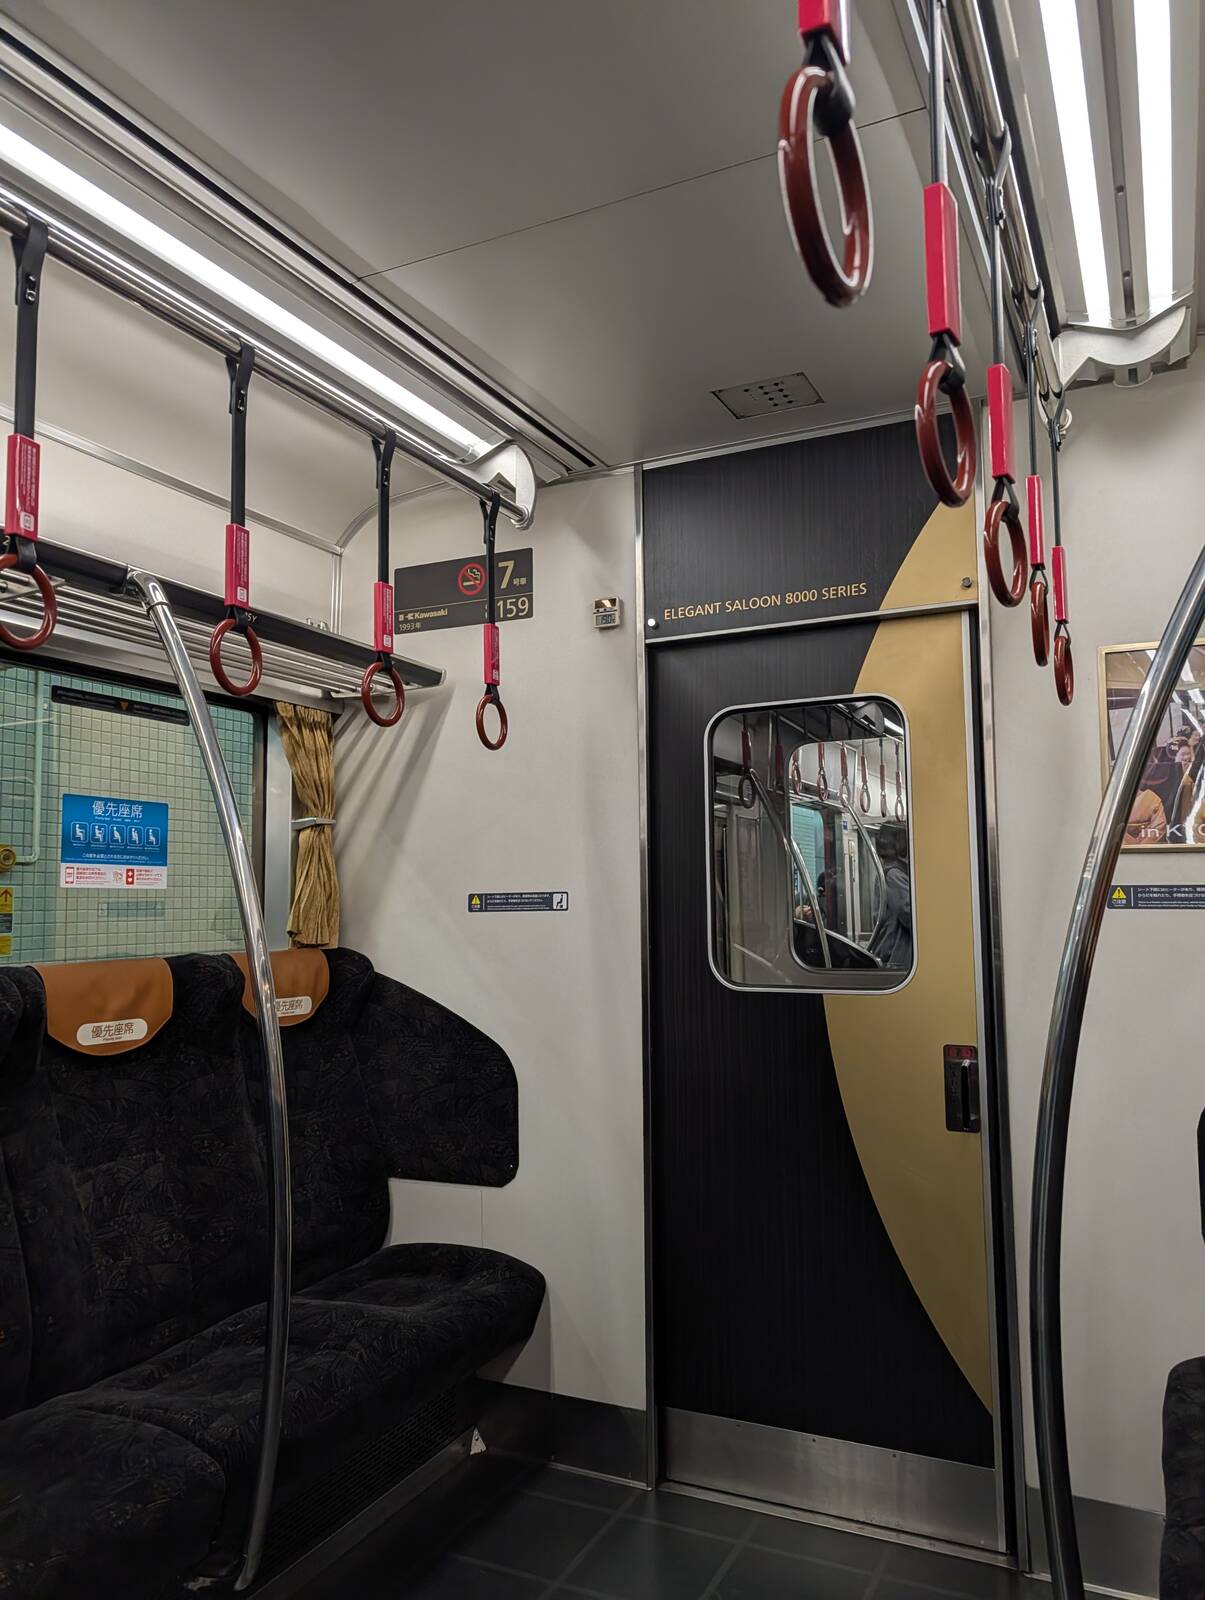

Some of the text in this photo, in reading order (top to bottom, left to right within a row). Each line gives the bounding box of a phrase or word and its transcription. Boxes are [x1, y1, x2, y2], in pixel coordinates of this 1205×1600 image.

[485, 597, 529, 619] 159
[664, 582, 867, 620] ELEGANT SALOON 8000 SERIES
[415, 607, 448, 619] Kawasaki
[92, 800, 143, 819] 優先座席
[1141, 825, 1160, 837] in
[91, 1022, 134, 1039] 優先座席
